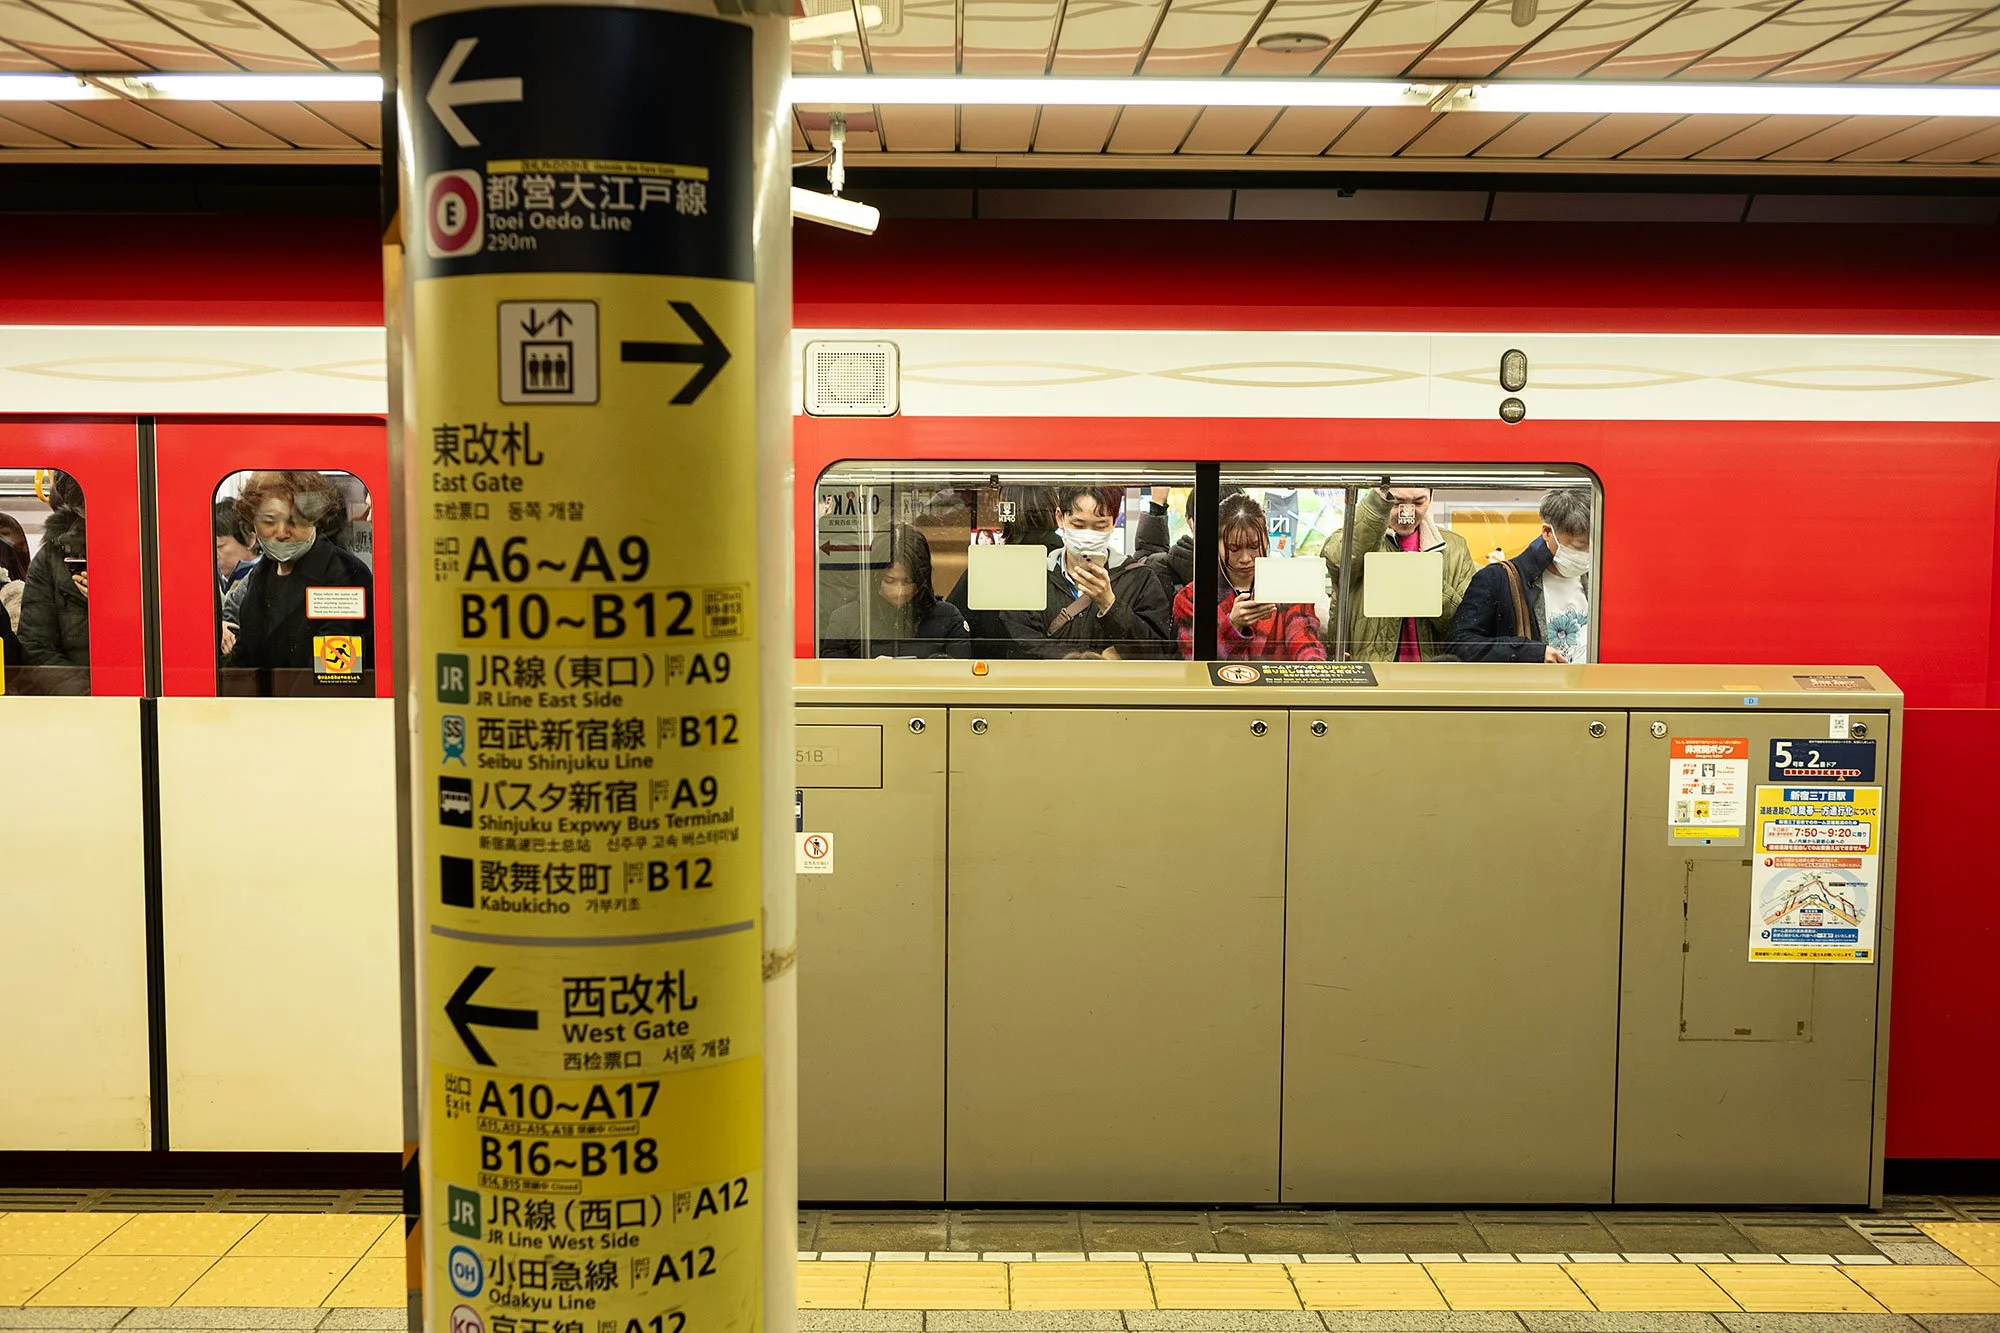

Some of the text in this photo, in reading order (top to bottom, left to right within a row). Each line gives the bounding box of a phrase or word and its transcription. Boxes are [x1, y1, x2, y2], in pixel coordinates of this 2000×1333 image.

[486, 174, 708, 216] 都営大江戸線
[446, 202, 458, 227] E
[486, 211, 632, 231] Toei Oedo Line
[486, 232, 538, 251] 290m
[432, 421, 544, 467] 東改札
[432, 472, 524, 493] East Gate
[440, 666, 465, 692] JR
[686, 652, 731, 685] A9
[475, 690, 624, 709] JR Line East Side
[476, 717, 647, 752] 西武新宿線
[680, 713, 739, 748] B12
[477, 753, 654, 774] Seibu Shinjuku Line
[479, 779, 637, 813] バスタ新宿
[670, 776, 718, 809] A9
[1790, 790, 1847, 801] 新宿三丁目駅
[478, 807, 735, 836] Shinjuku Expwy Bus Terminal
[479, 860, 613, 896] 歌舞伎町
[648, 857, 714, 892] B12
[480, 894, 571, 915] Kabukicho
[561, 969, 698, 1019] 西改札
[562, 1019, 690, 1044] West Gate
[563, 1036, 732, 1071] 西检票口 서쪽 개찰
[445, 1072, 472, 1096] 出口
[445, 1095, 472, 1114] Exit
[692, 1176, 750, 1220] A12
[452, 1198, 475, 1227] JR
[487, 1229, 640, 1250] JR Line West Side
[454, 1260, 476, 1281] OH
[487, 1254, 619, 1292] 小田急線
[651, 1245, 717, 1286] A12
[488, 1289, 597, 1313] Odakyu Line
